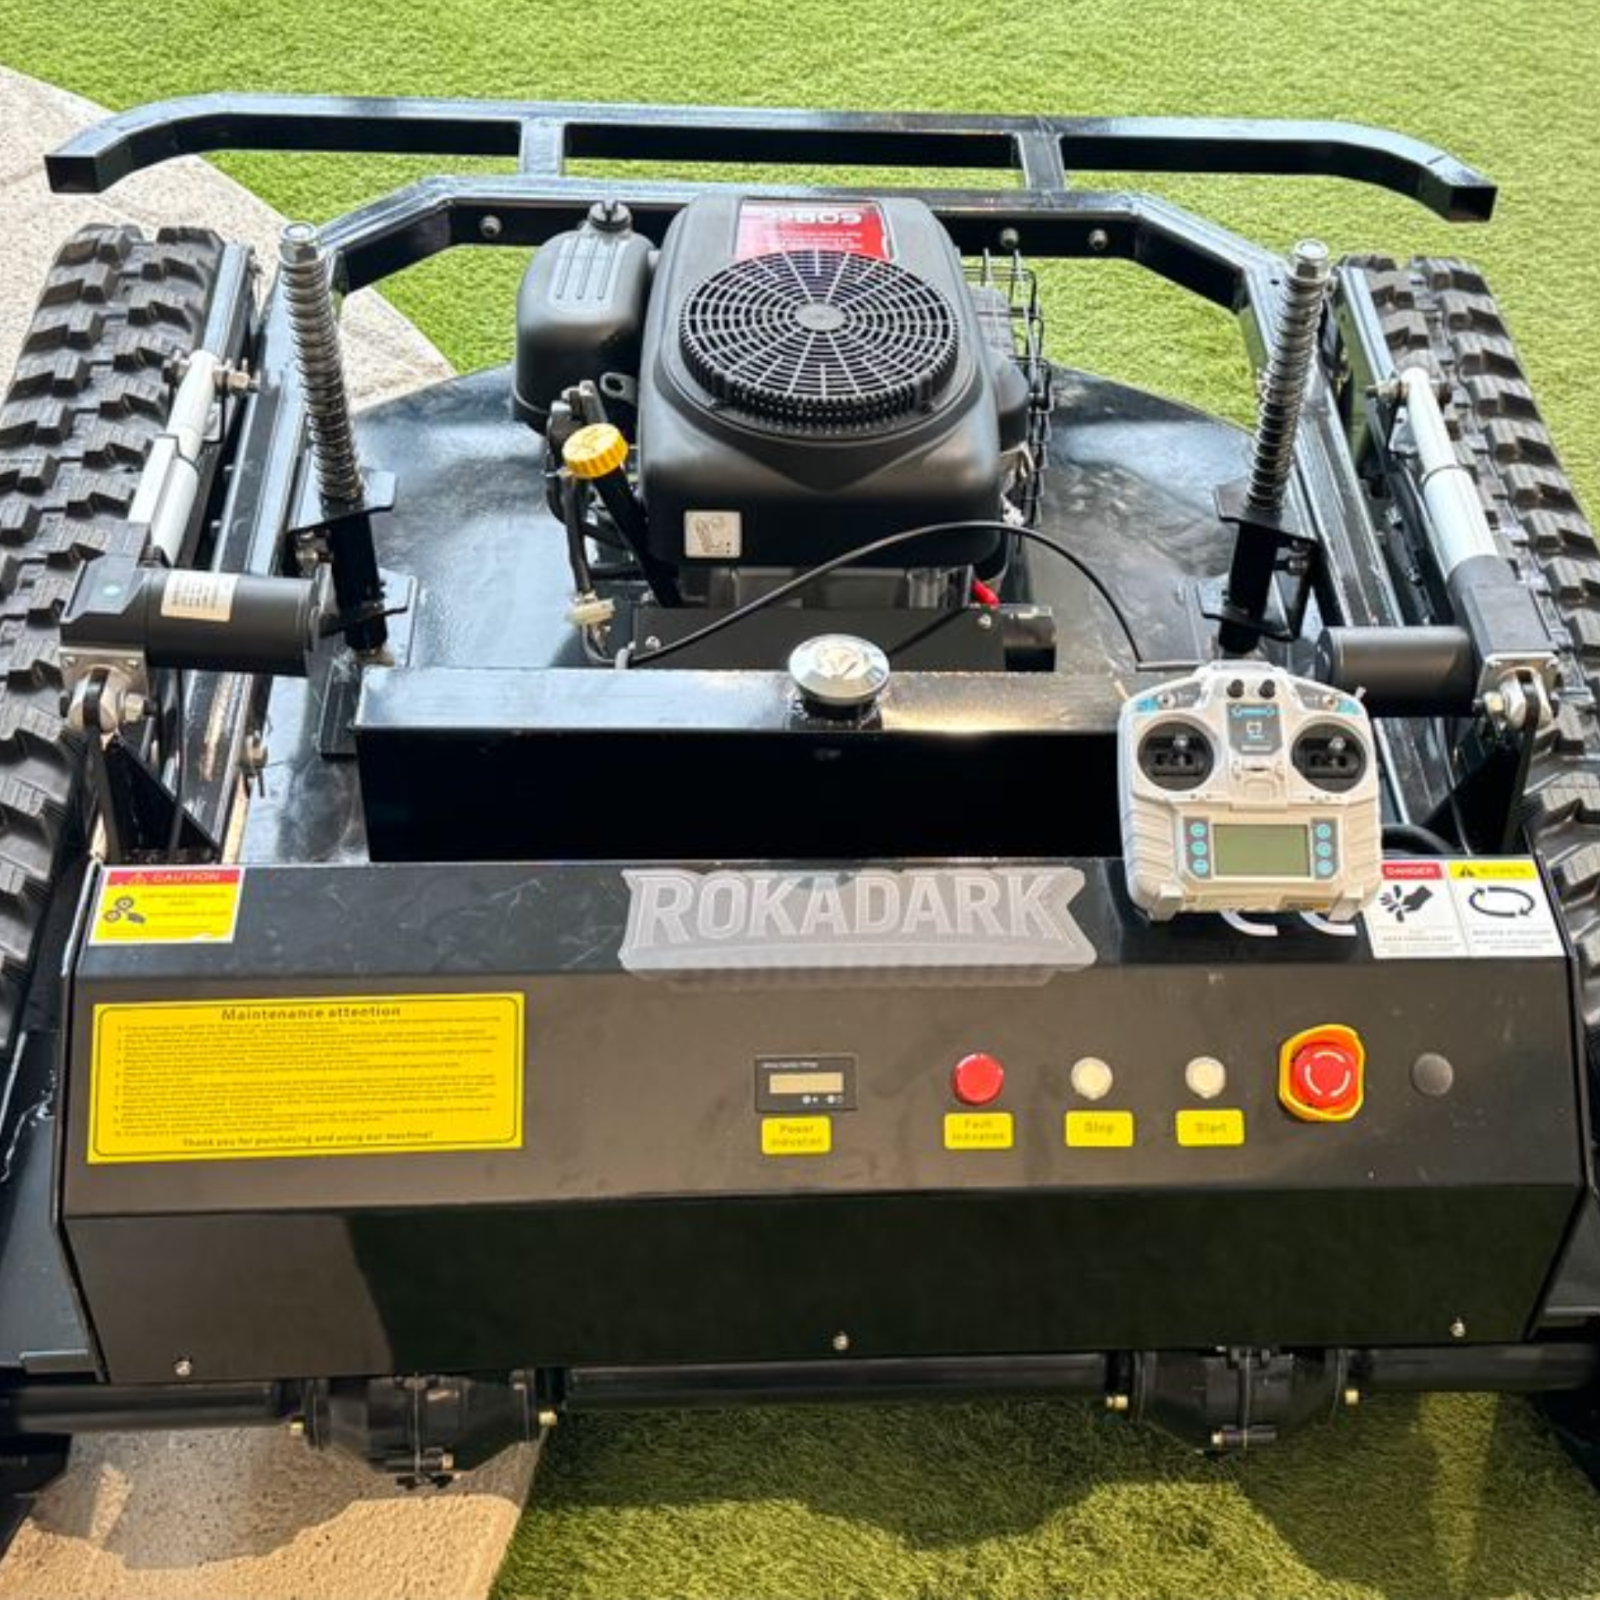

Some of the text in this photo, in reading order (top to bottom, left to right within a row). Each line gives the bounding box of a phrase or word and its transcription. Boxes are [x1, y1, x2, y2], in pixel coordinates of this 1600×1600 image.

[153, 872, 221, 883] CAUTION
[1385, 866, 1435, 876] DANGER
[632, 870, 1078, 949] ROKADARK
[221, 1005, 400, 1021] Maintenance attention
[1084, 1121, 1114, 1135] Stop
[1195, 1121, 1227, 1134] Start
[183, 1137, 213, 1147] Thank
[216, 1138, 235, 1148] you
[238, 1136, 253, 1145] for
[255, 1134, 312, 1147] purchasing
[315, 1132, 334, 1142] and
[336, 1133, 363, 1144] using
[366, 1133, 383, 1141] our
